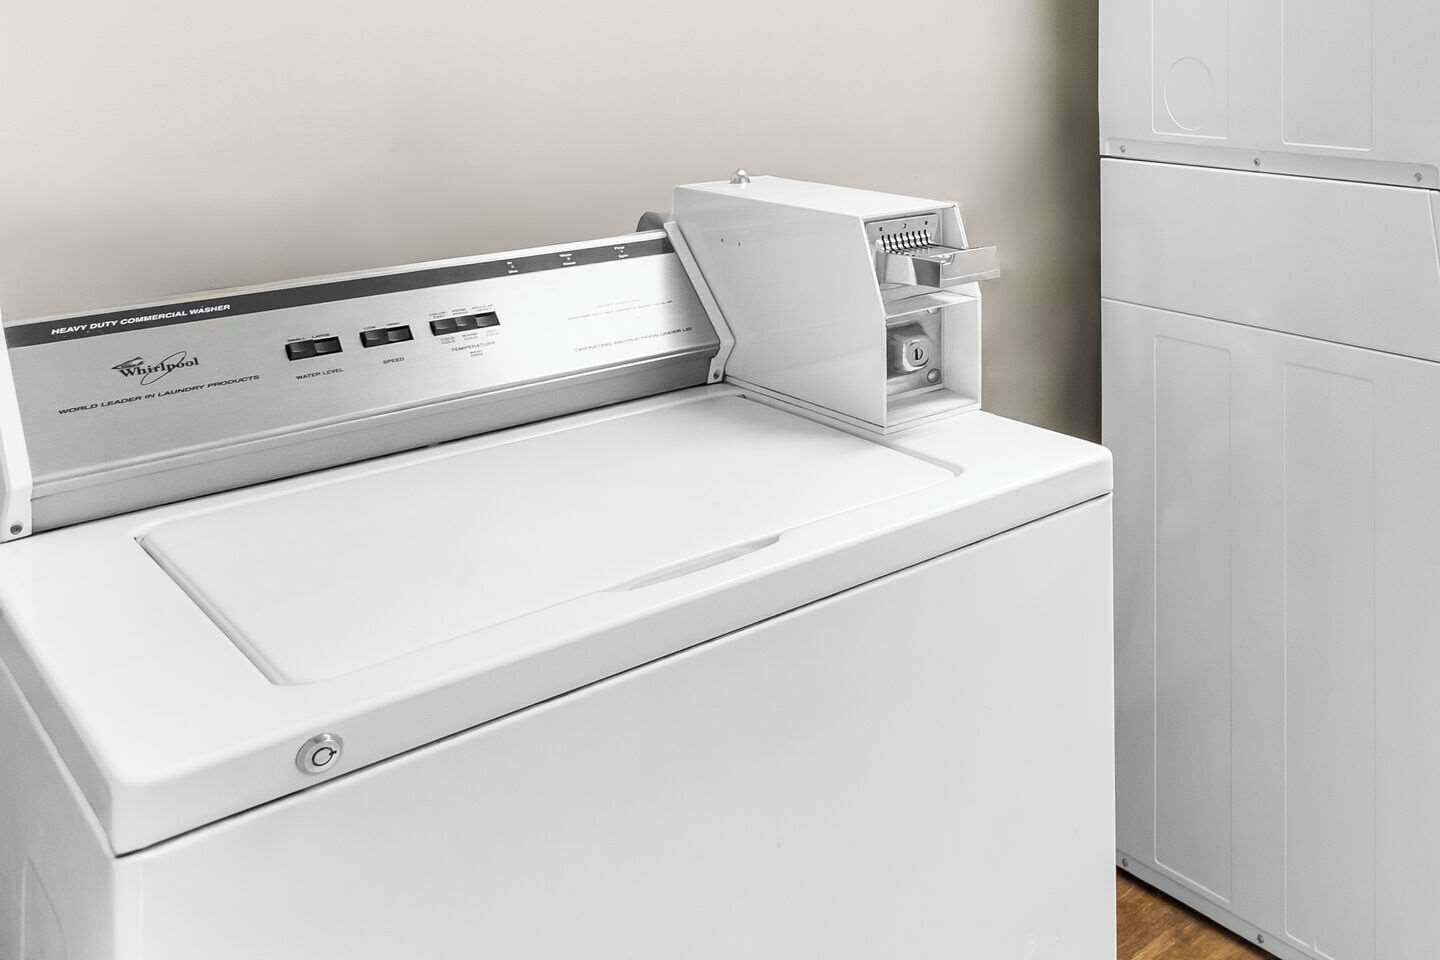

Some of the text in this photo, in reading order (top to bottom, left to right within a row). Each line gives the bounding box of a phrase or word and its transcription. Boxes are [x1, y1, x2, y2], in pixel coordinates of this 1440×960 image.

[51, 304, 231, 336] HEAVY DUTY COMMERCIAL WASHER
[119, 356, 200, 378] Whirlpool
[383, 356, 405, 364] SPEED
[295, 368, 345, 380] WATER LEVEL
[58, 374, 260, 415] WORLD LEADER IN LAUNDRY PRODUCTS
